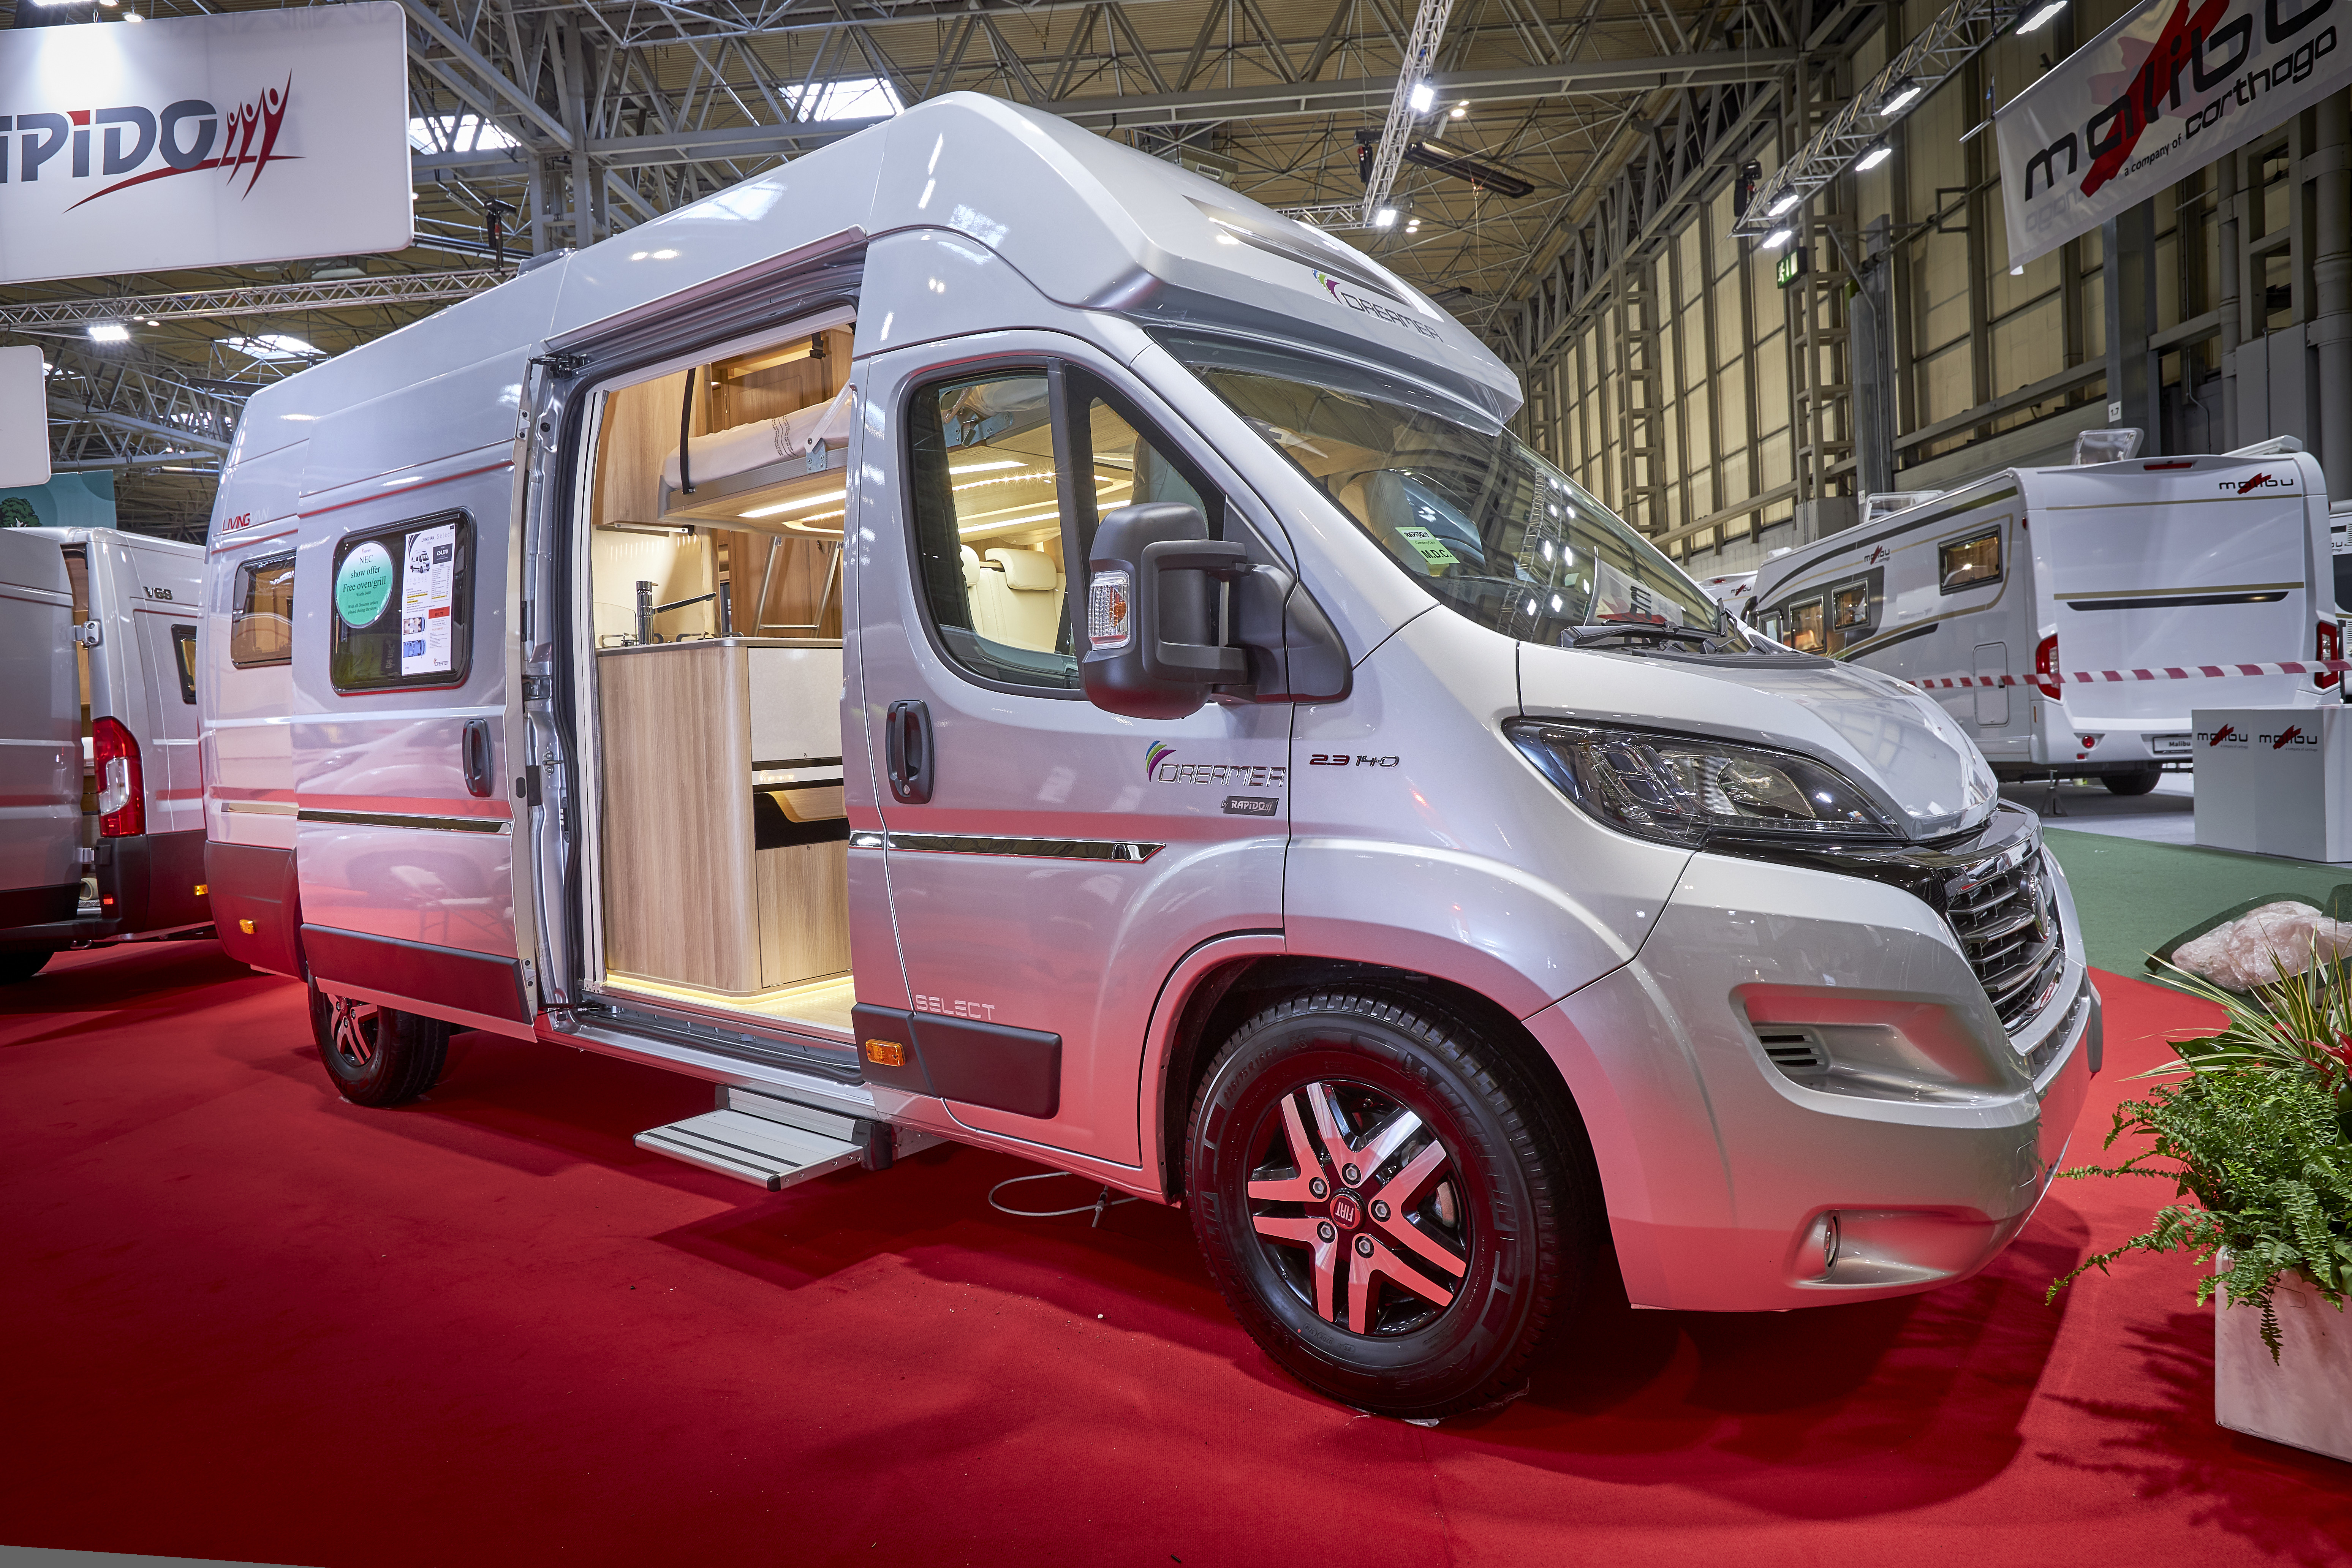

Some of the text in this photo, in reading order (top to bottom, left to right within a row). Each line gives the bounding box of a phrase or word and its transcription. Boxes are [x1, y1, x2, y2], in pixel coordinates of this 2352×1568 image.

[2131, 144, 2170, 174] company
[2172, 133, 2182, 150] of
[2185, 25, 2337, 140] carthago
[1339, 291, 1444, 343] DREAMER
[359, 555, 373, 565] NEC
[1421, 549, 1452, 559] M.D.C.
[367, 566, 381, 575] offer
[343, 576, 386, 593] Free oven/grill
[1355, 755, 1400, 767] 140
[1157, 763, 1286, 787] DREAMER
[916, 994, 995, 1020] SELECT
[1335, 1201, 1354, 1222] FIAT
